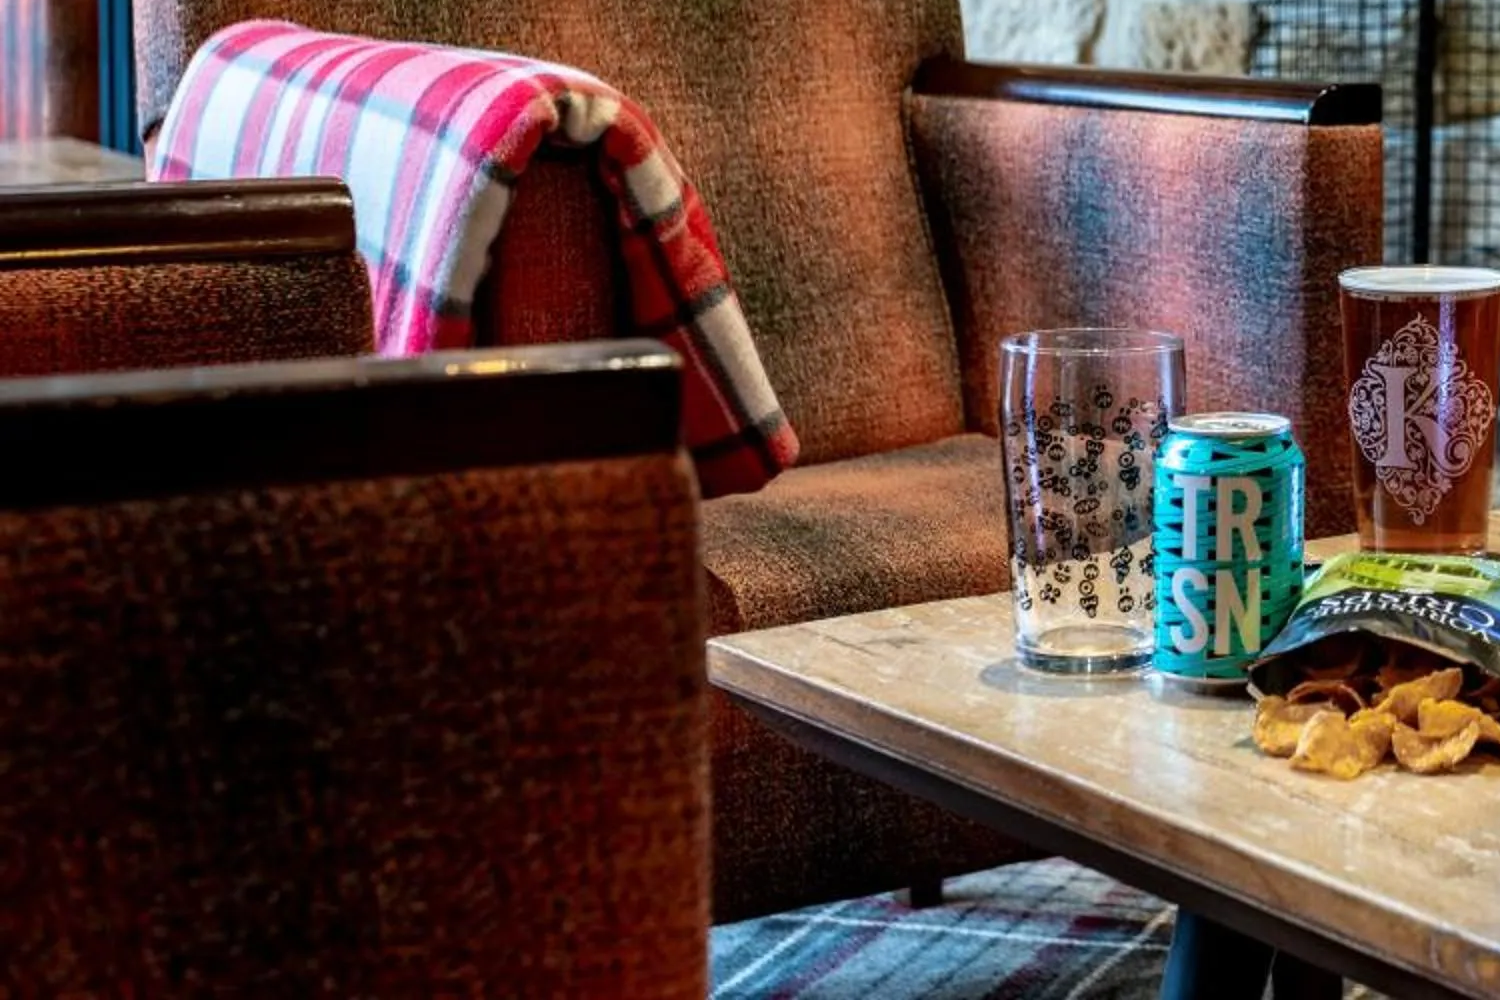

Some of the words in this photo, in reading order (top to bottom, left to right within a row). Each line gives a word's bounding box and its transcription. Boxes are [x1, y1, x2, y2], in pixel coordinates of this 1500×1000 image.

[1376, 366, 1475, 476] K
[1173, 475, 1262, 561] TR
[1170, 567, 1260, 654] SN
[1306, 602, 1490, 643] YORKSHIRE
